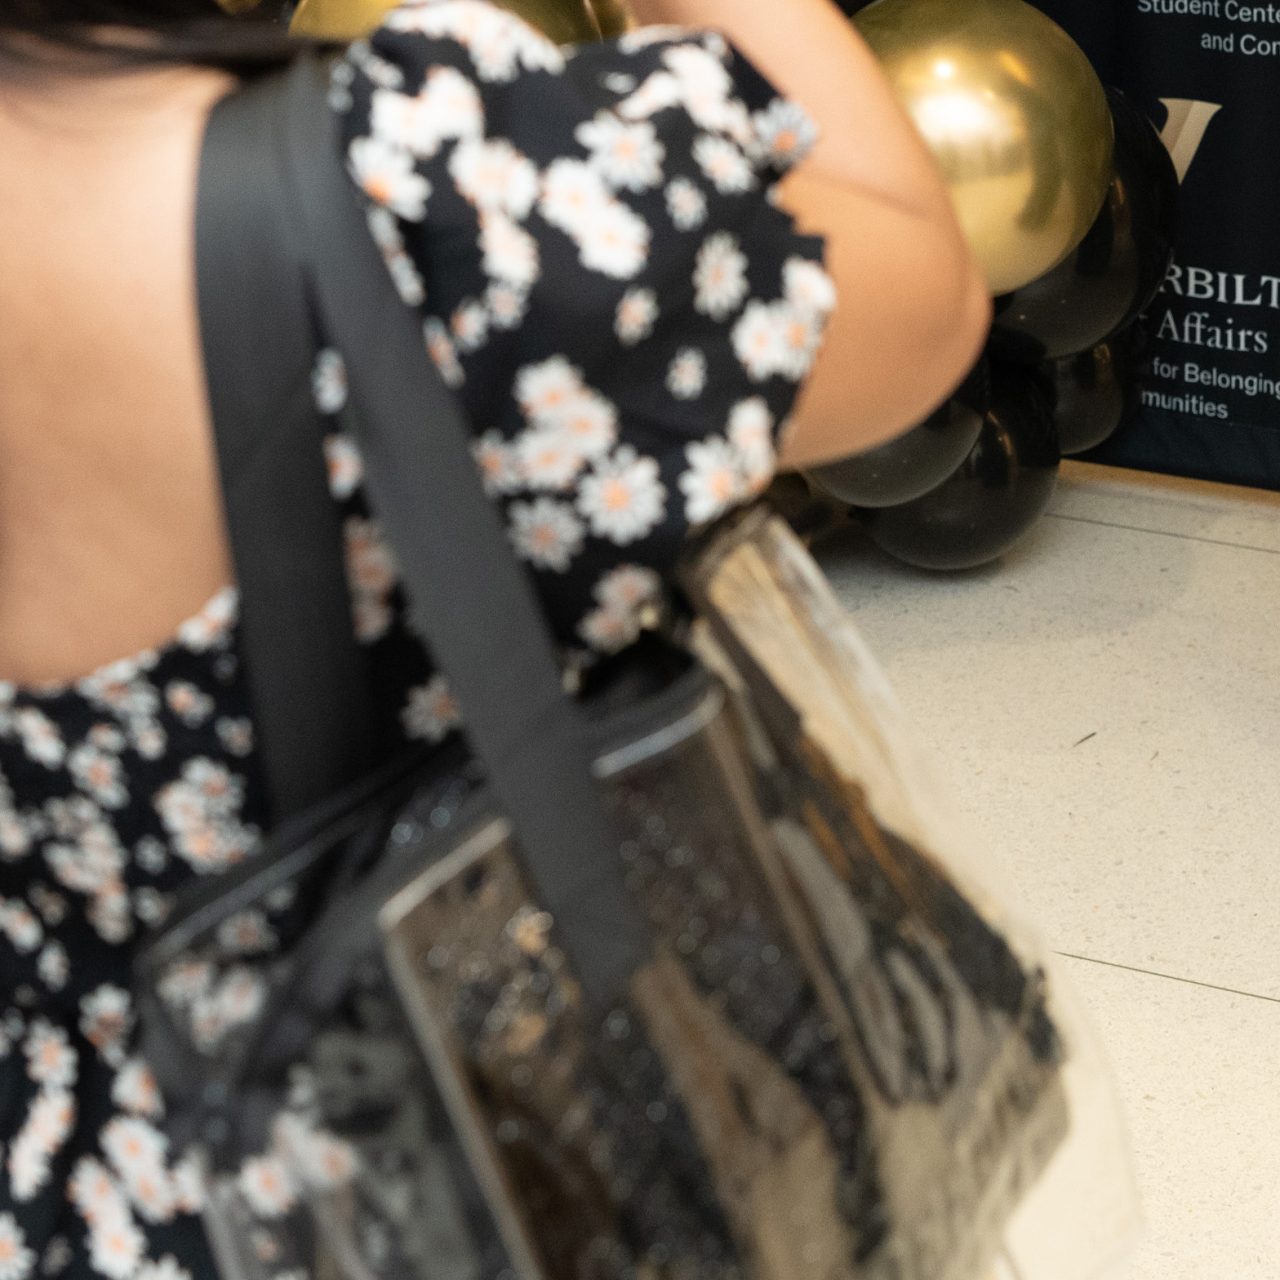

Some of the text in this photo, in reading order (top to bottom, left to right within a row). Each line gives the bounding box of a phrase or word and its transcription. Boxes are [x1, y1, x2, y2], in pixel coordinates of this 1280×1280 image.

[1201, 33, 1234, 52] and
[1156, 309, 1268, 353] Affairs
[1152, 357, 1178, 380] for
[1141, 390, 1228, 419] munities
